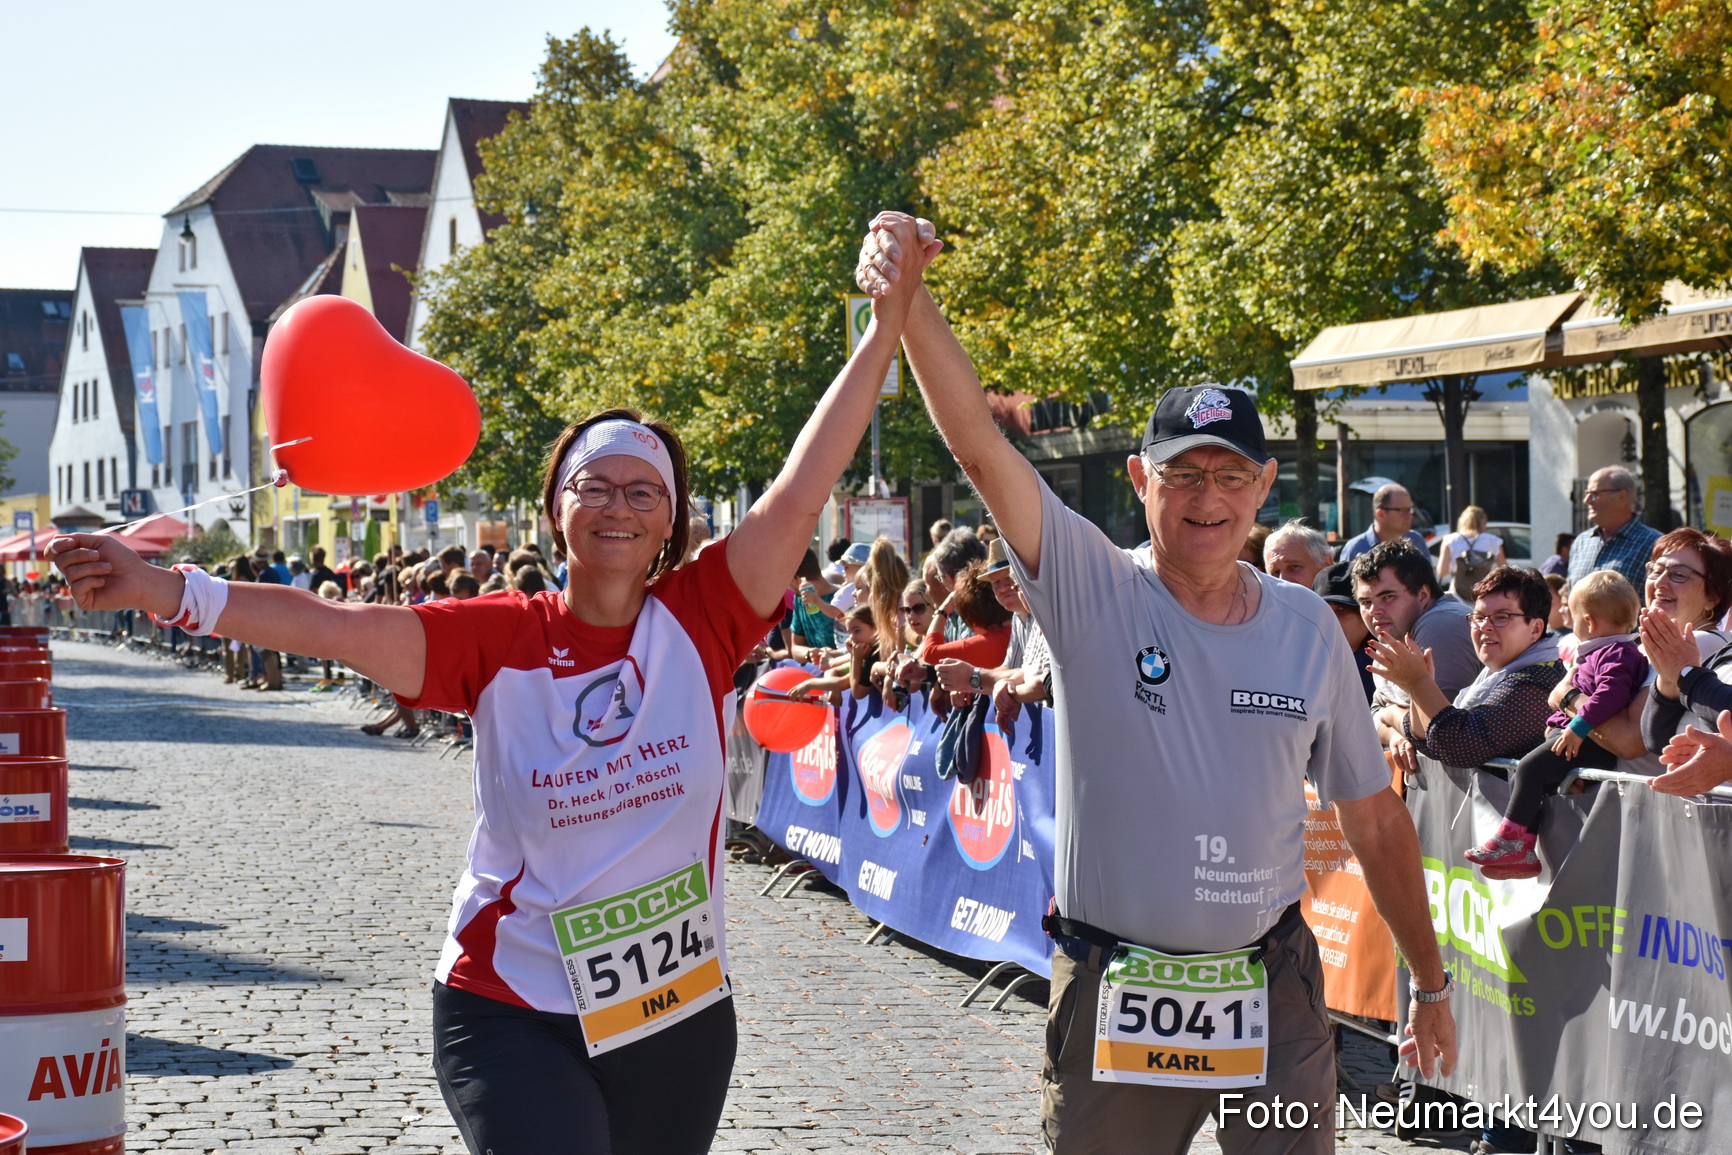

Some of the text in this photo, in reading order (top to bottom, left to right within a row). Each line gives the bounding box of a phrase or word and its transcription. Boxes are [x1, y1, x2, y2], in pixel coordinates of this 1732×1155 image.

[548, 657, 575, 667] erima
[1231, 690, 1307, 715] BOCK
[1285, 712, 1308, 722] concepts
[532, 735, 690, 788] LAUFEN MIT HERZ
[548, 799, 568, 811] Dr.
[637, 762, 681, 786] Röschl
[550, 782, 685, 829] Leistungsdiagnostik
[785, 825, 808, 852] GET
[961, 823, 985, 842] SPORTS
[1194, 834, 1235, 864] 19.
[858, 860, 876, 891] GET
[1194, 866, 1273, 883] Neumarkter
[567, 873, 697, 945] BOCK
[1194, 887, 1264, 905] Stadtlauf
[951, 896, 978, 931] GET
[1421, 862, 1522, 978] BOCK
[587, 919, 703, 999] 5124
[1117, 955, 1253, 986] BOCK
[1461, 959, 1472, 993] by
[642, 988, 680, 1018] INA
[1117, 992, 1243, 1040] 5041
[1147, 1051, 1216, 1072] KARL
